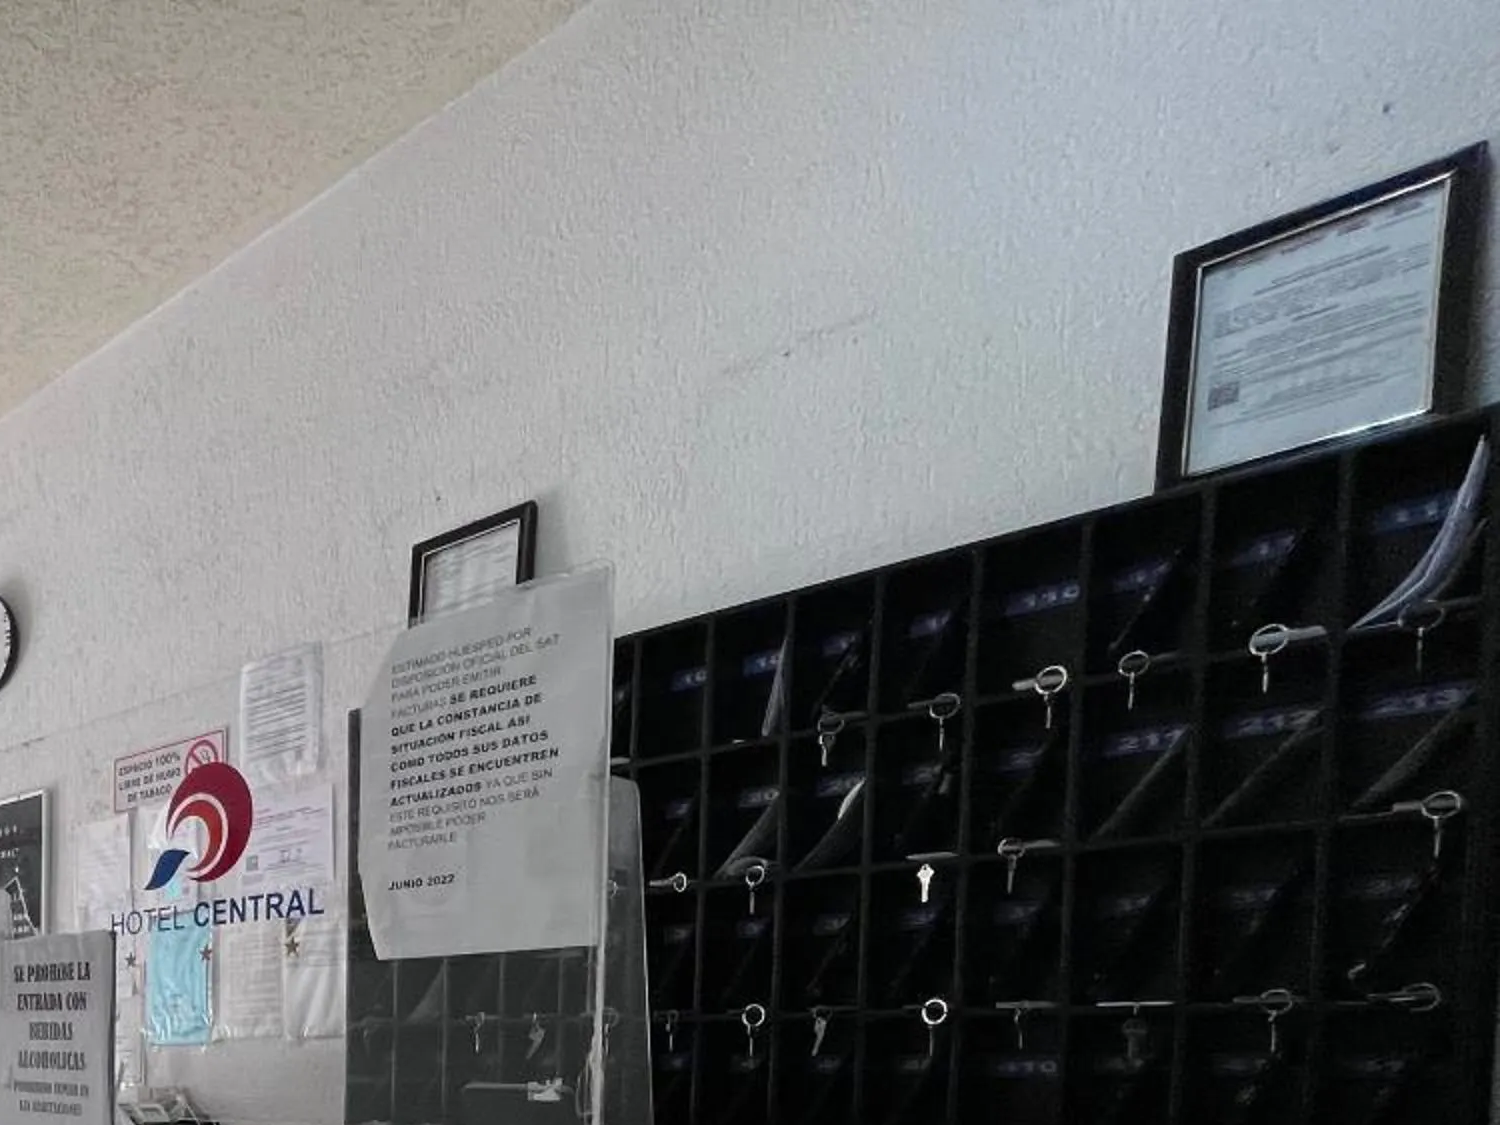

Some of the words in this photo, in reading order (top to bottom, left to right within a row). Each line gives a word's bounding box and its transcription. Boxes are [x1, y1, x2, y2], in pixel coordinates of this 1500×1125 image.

[509, 642, 534, 658] DEL
[535, 632, 561, 650] SAT
[391, 650, 446, 675] ESTIMADO
[422, 676, 460, 696] PODER
[449, 691, 466, 705] SE
[469, 673, 537, 700] REQUIERE
[391, 722, 416, 737] QUE
[419, 718, 433, 732] LA
[437, 699, 521, 727] CONSTANCIA
[524, 692, 543, 706] DE
[459, 718, 503, 740] FISCAL
[390, 755, 425, 773] COMO
[428, 746, 469, 763] TODOS
[473, 739, 499, 756] SUS
[502, 729, 549, 749] DATOS
[390, 768, 446, 791] FISCALES
[449, 764, 466, 778] SE
[468, 746, 560, 775] ENCUENTREN
[140, 783, 173, 801] TABACO
[390, 780, 482, 807] ACTUALIZADOS
[485, 777, 501, 789] YA
[502, 770, 529, 787] QUE
[531, 767, 553, 782] SIN
[389, 808, 415, 824] ESTE
[417, 796, 477, 818] REQUISITO
[479, 792, 504, 808] NOS
[445, 810, 487, 829] PODER
[387, 830, 457, 851] FACTURABLE
[388, 877, 423, 891] JUNIO
[427, 873, 455, 888] 2022
[111, 905, 185, 937] HOTEL
[193, 887, 325, 927] CENTRAL
[13, 964, 25, 983] SE
[77, 961, 91, 981] LA
[16, 991, 62, 1012] ENTRADA
[65, 991, 88, 1011] CON
[28, 1021, 73, 1041] BEBIDAS
